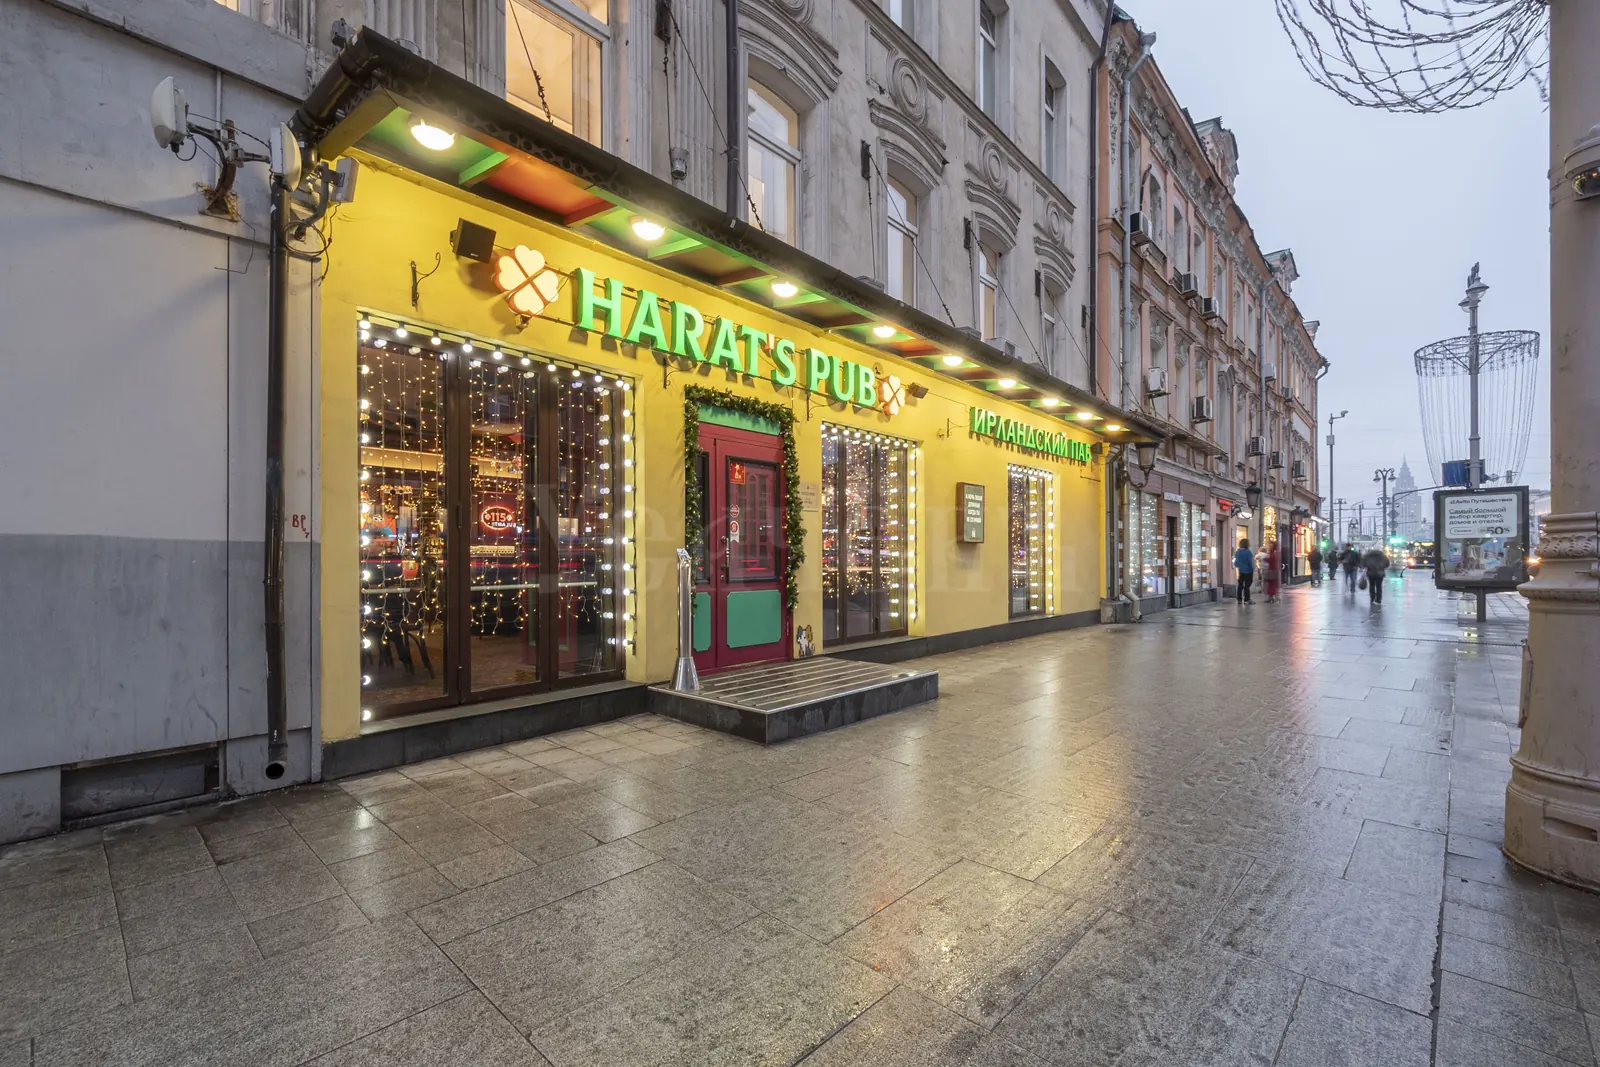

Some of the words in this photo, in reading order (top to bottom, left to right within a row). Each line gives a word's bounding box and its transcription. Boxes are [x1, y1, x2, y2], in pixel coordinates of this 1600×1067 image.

[574, 266, 797, 387] HARAT'S
[804, 347, 877, 406] PUB
[970, 406, 1068, 458] ИРЛАНДСКИЙ
[1071, 439, 1091, 462] ПАБ
[490, 512, 507, 522] 115
